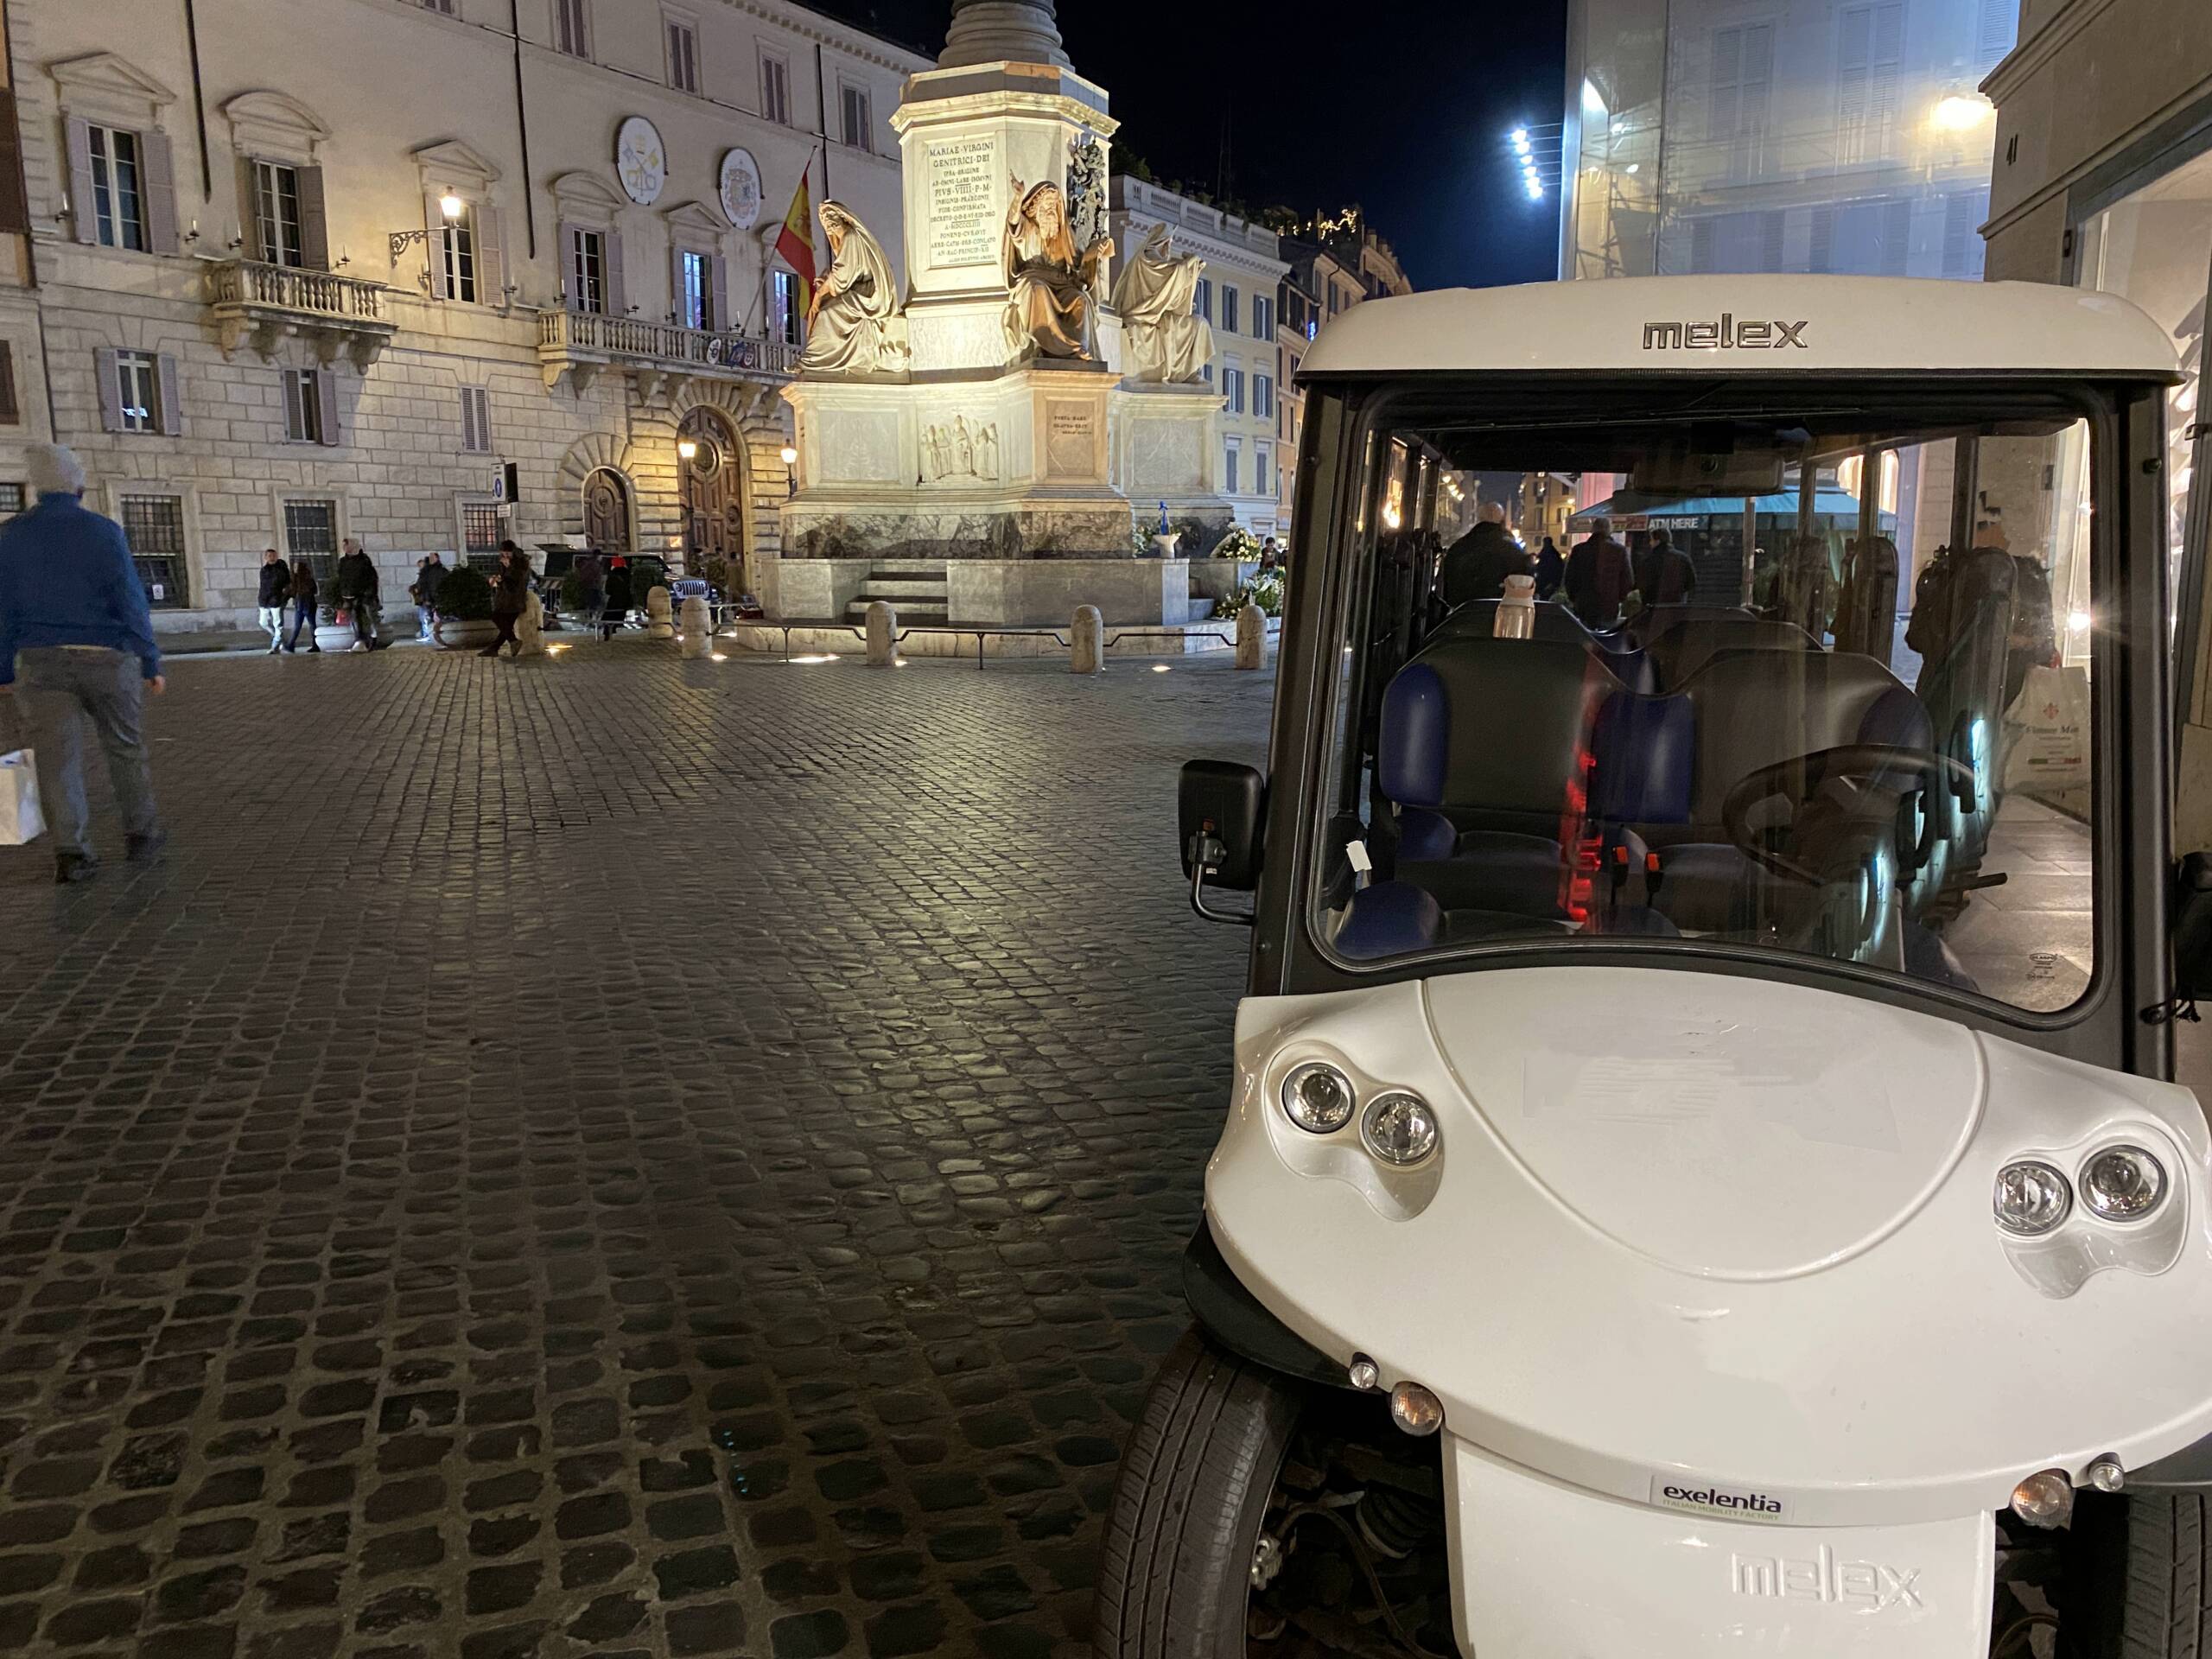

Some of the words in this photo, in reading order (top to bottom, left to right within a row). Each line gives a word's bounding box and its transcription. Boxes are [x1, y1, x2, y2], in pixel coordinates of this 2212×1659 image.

[930, 146, 960, 156] MARIAE
[963, 142, 994, 152] VIRGINI
[933, 156, 974, 168] GENITRICI
[976, 154, 989, 163] DEI
[934, 188, 951, 197] PIVS
[1643, 313, 1809, 350] melex
[1649, 518, 1670, 530] ATM
[1670, 518, 1699, 529] HERE
[1663, 1485, 1782, 1513] exelentia
[1662, 1499, 1696, 1510] ITALIAN
[1698, 1505, 1738, 1516] MOBILITY
[1738, 1510, 1780, 1521] FACTORY
[1731, 1543, 1924, 1608] melex
